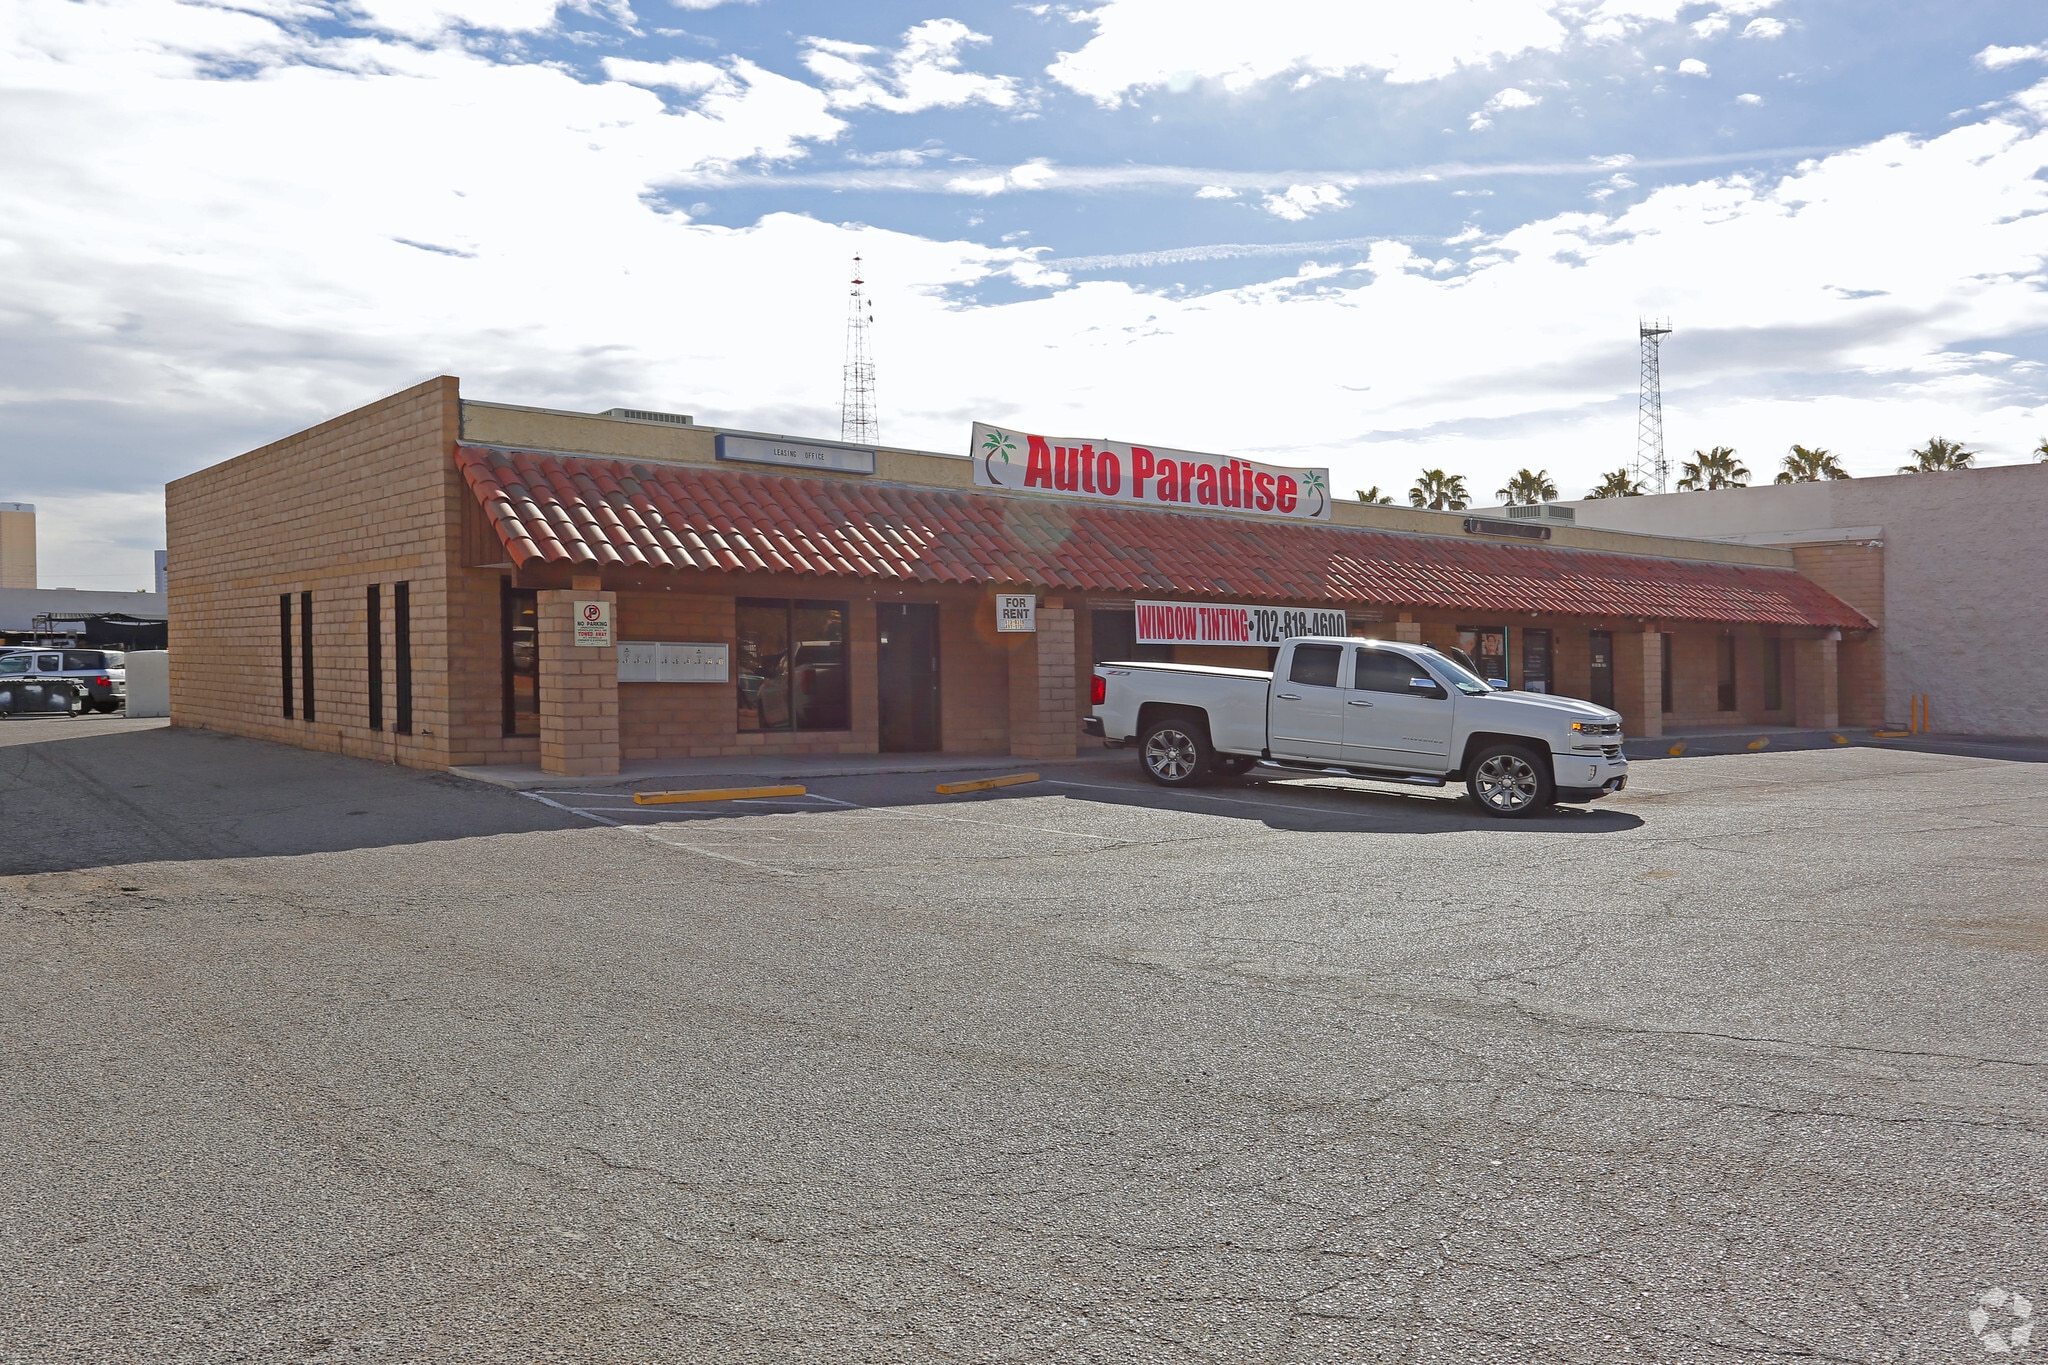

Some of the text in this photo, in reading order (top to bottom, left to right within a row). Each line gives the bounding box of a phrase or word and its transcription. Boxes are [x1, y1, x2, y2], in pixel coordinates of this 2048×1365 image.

[773, 448, 825, 461] LEASING OFFICE
[1024, 435, 1298, 514] Auto Paradise
[1005, 597, 1026, 608] FOR
[1002, 608, 1030, 619] RENT
[1137, 605, 1197, 641] WINDOW
[1199, 607, 1249, 642] TINTING
